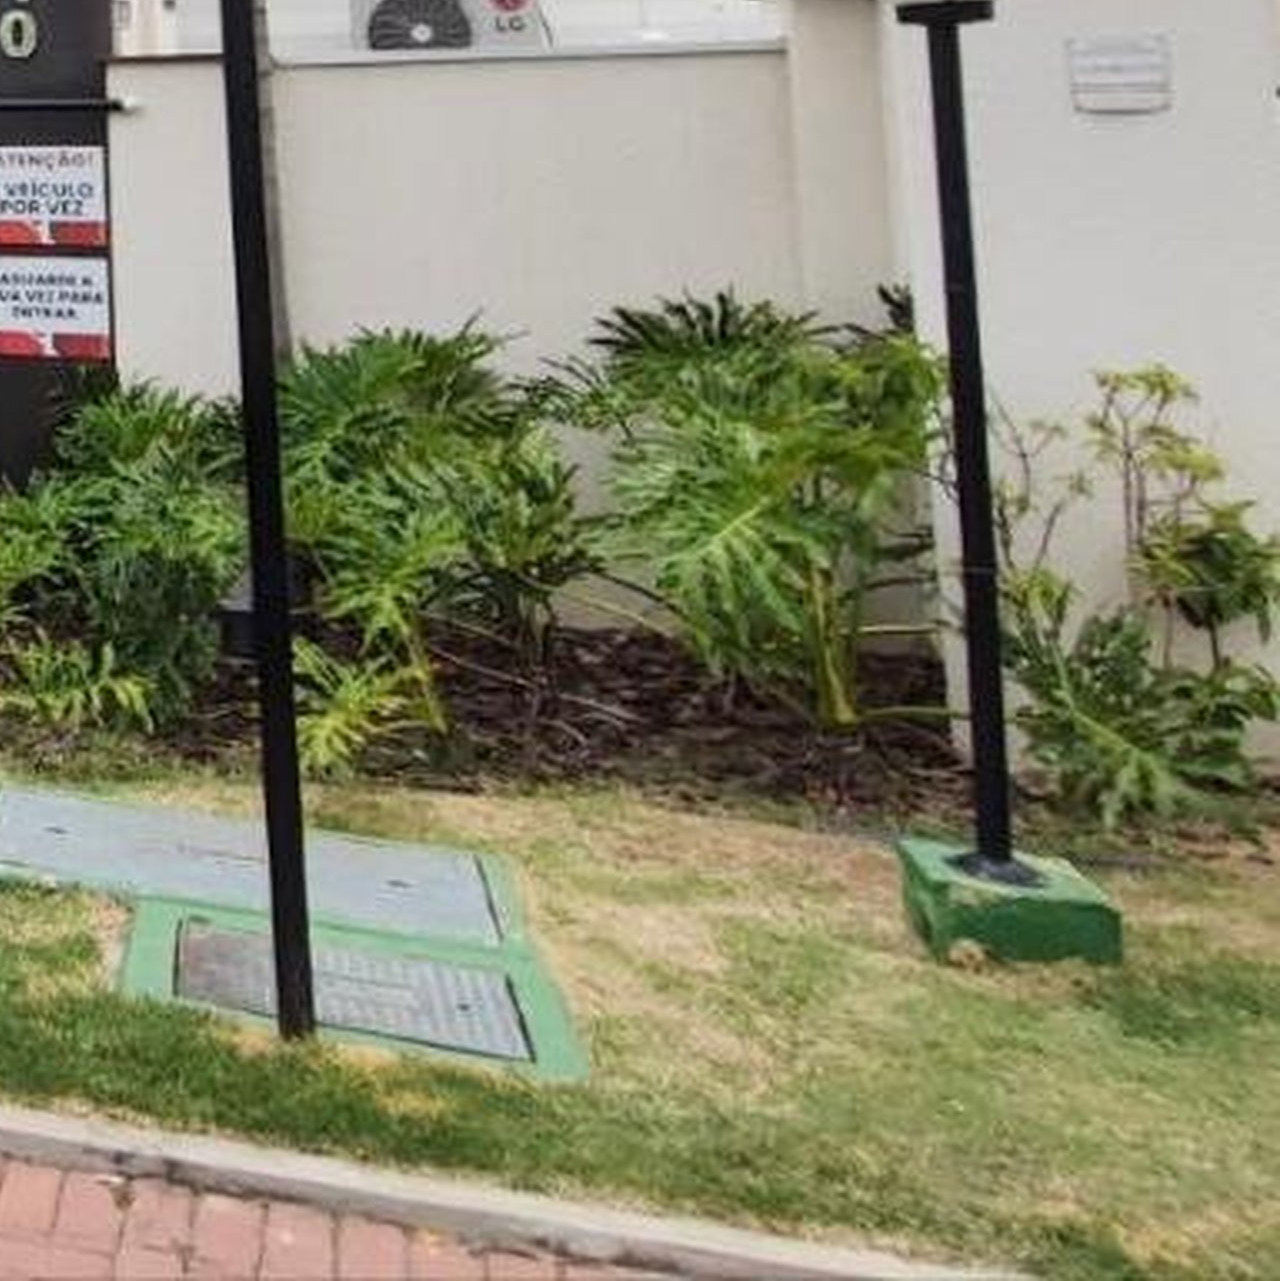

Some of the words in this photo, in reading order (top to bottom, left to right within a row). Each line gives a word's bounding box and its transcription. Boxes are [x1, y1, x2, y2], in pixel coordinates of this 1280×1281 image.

[493, 15, 528, 32] LG
[0, 199, 40, 215] POR
[45, 199, 84, 216] VEZ
